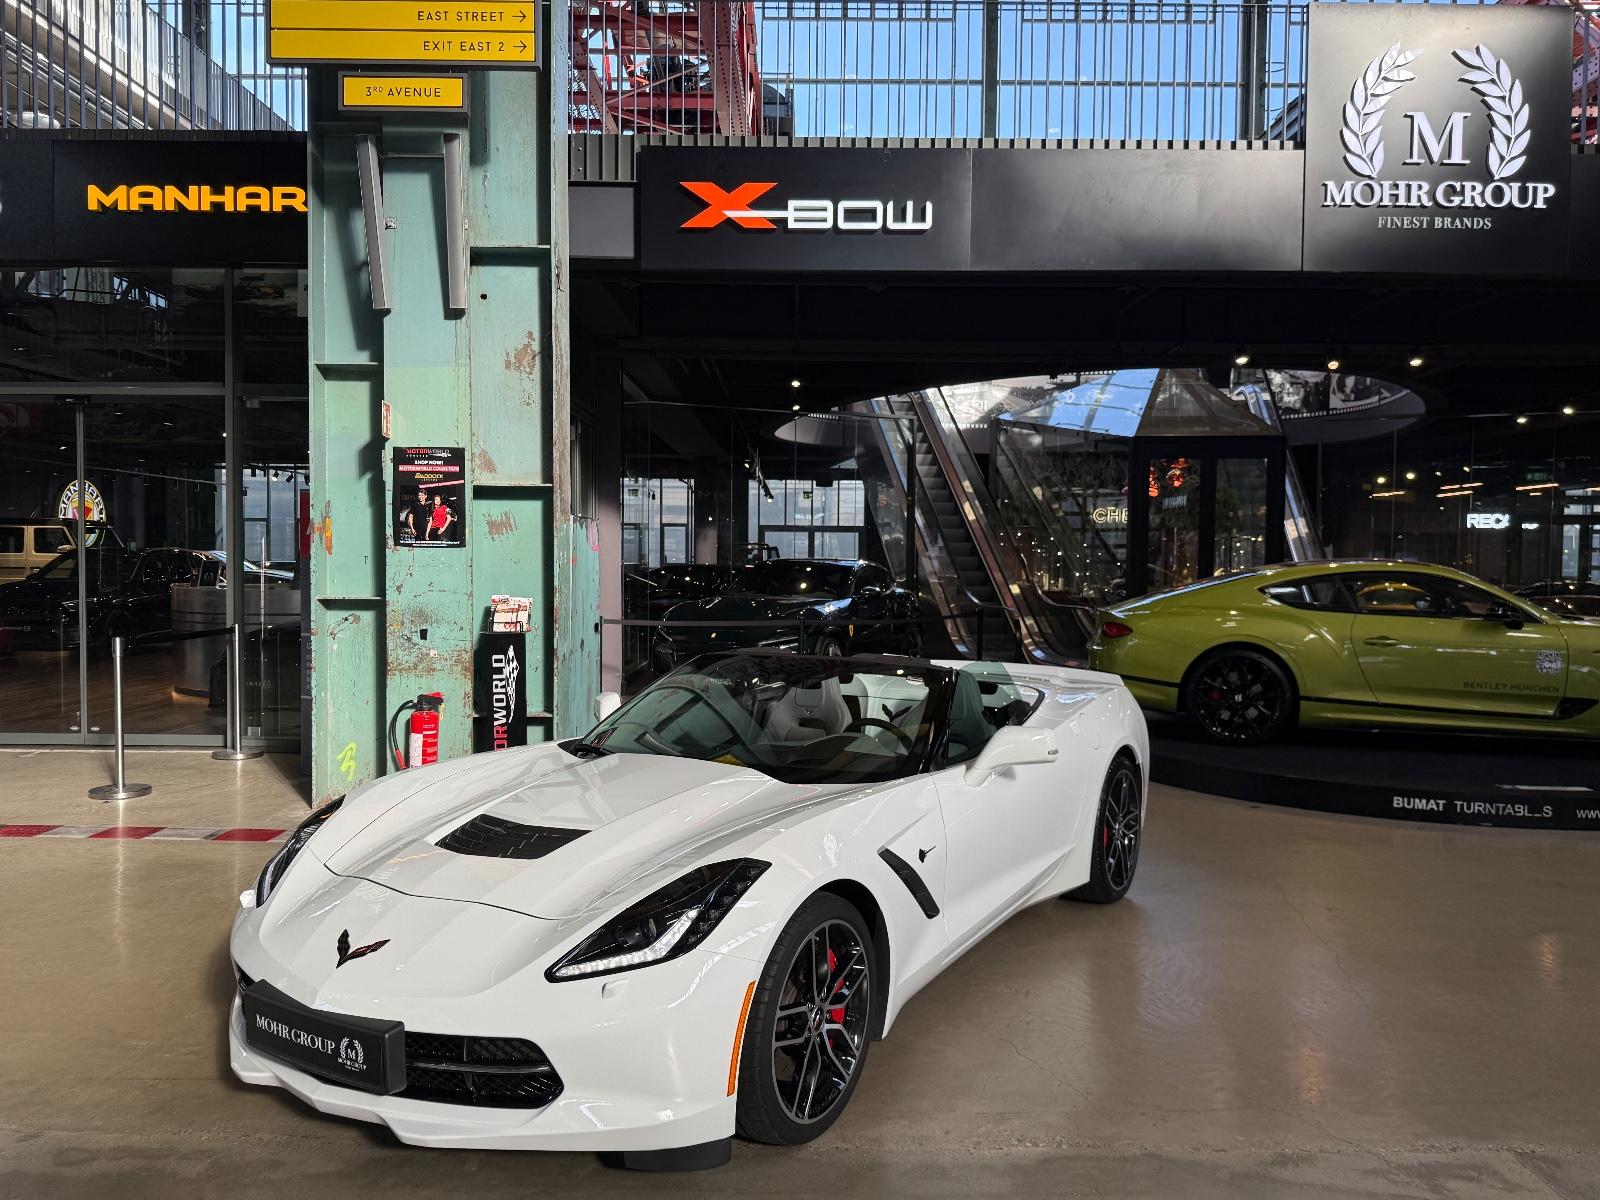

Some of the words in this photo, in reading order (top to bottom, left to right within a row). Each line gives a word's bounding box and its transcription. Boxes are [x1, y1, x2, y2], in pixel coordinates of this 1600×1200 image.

[417, 10, 449, 21] EAST
[456, 11, 505, 22] STREET
[423, 40, 453, 51] EXIT
[460, 41, 491, 52] EAST
[498, 41, 505, 52] 2
[365, 86, 384, 97] 3RD
[387, 87, 441, 98] AVENUE
[1404, 111, 1471, 164] M
[1322, 180, 1433, 207] MOHR
[1435, 181, 1556, 209] GROUP
[679, 181, 933, 230] X-BOW
[1377, 216, 1430, 229] FINEST
[1434, 217, 1492, 230] BRANDS
[1463, 681, 1508, 691] BENTLEY
[1392, 796, 1447, 811] BUMAT
[1576, 809, 1600, 818] ww
[255, 1013, 291, 1040] MOHR
[291, 1027, 336, 1054] GROUP
